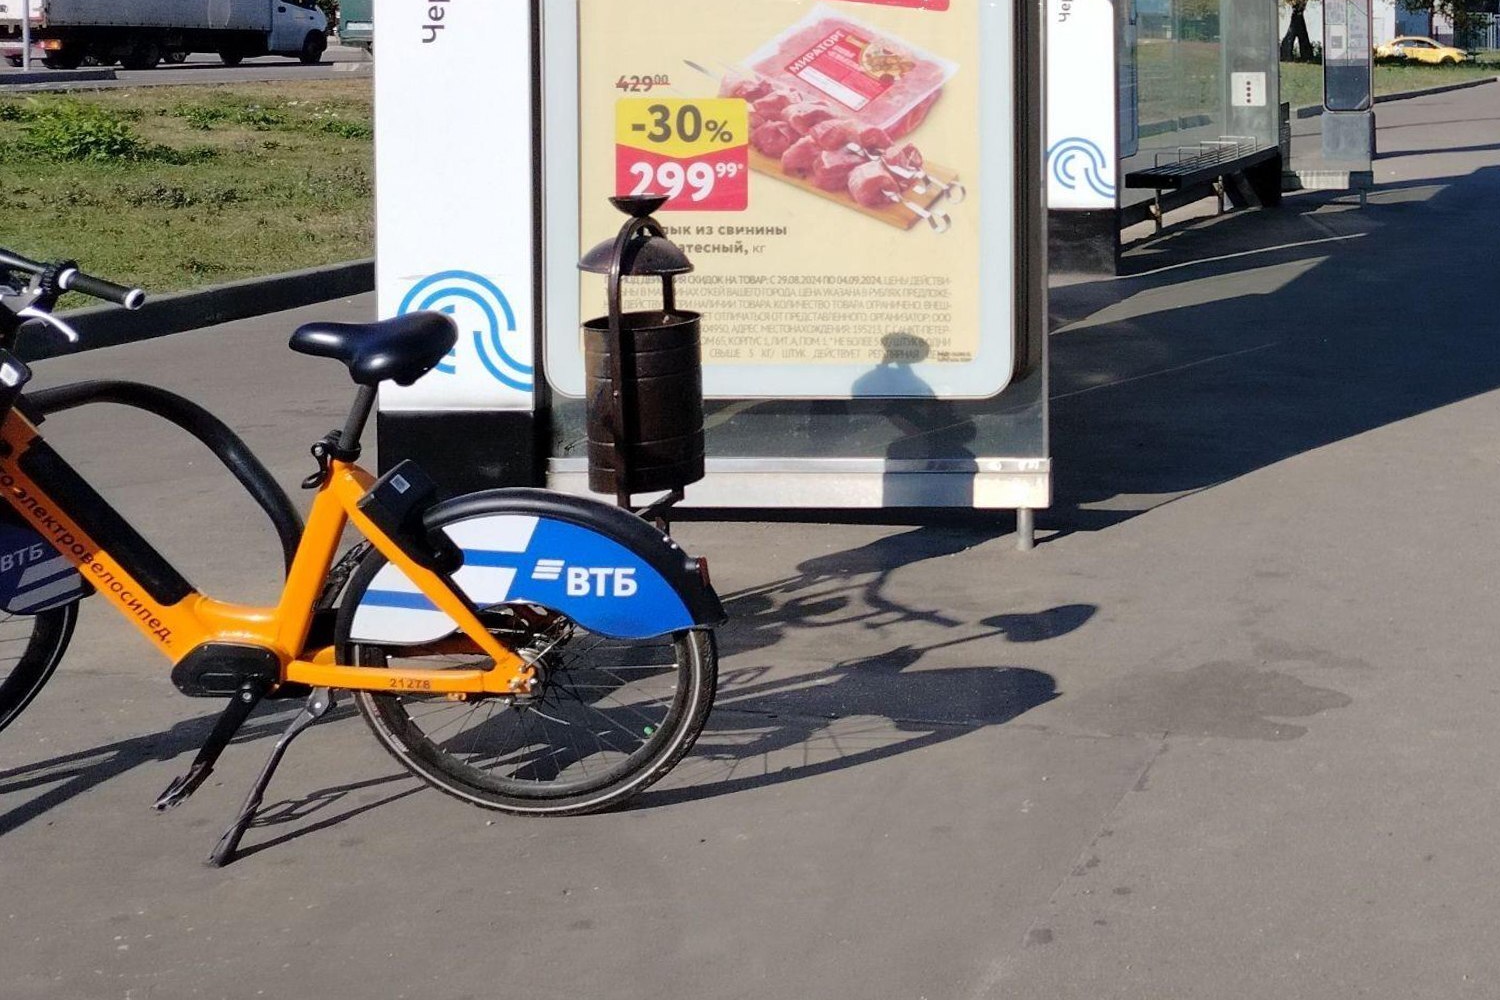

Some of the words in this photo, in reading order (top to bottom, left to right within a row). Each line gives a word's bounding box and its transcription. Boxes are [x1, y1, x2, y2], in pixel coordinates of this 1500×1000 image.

[788, 30, 846, 74] МИРАТОРГ
[631, 103, 734, 144] -30%
[695, 225, 714, 236] из
[717, 225, 788, 236] свинины
[752, 245, 766, 254] кг
[687, 275, 723, 285] СКИДОК
[725, 275, 738, 285] НА
[824, 275, 836, 285] ПО
[0, 542, 44, 572] ВТБ
[566, 566, 639, 598] ВТБ
